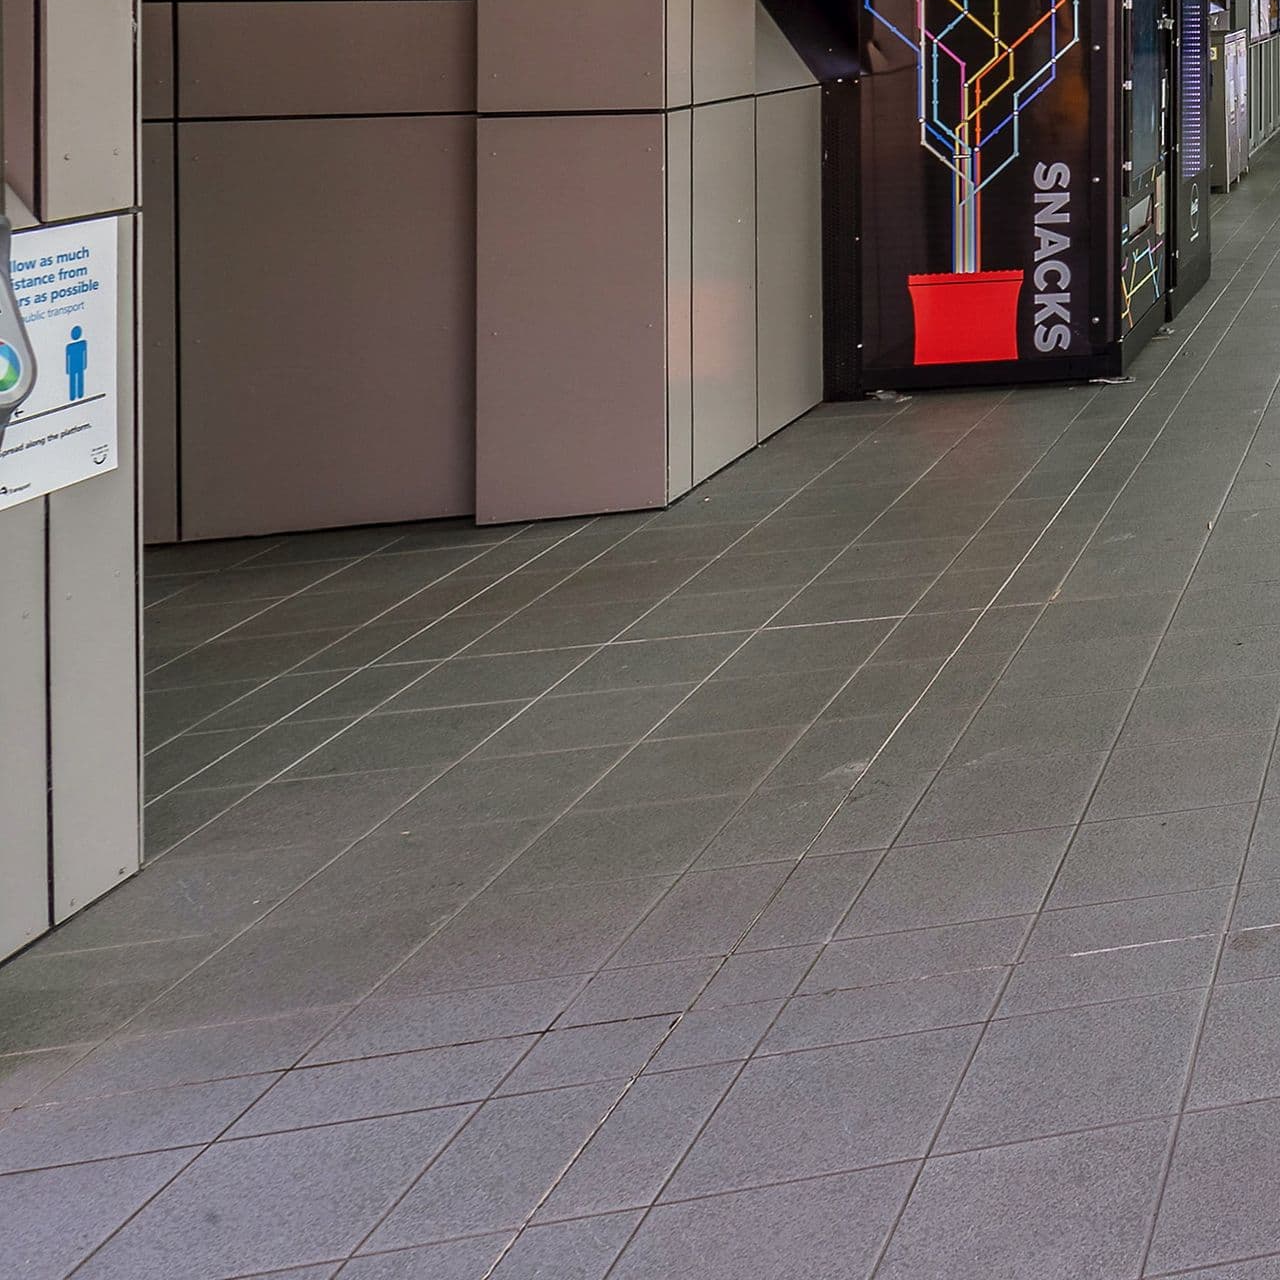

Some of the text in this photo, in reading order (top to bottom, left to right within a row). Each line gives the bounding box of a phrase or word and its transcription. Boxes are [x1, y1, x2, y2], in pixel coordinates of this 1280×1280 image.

[39, 255, 53, 268] as
[56, 246, 90, 264] much
[1034, 161, 1072, 353] SNACKS
[58, 266, 88, 281] from
[34, 292, 48, 304] as
[50, 279, 100, 303] possible
[47, 301, 85, 318] transport
